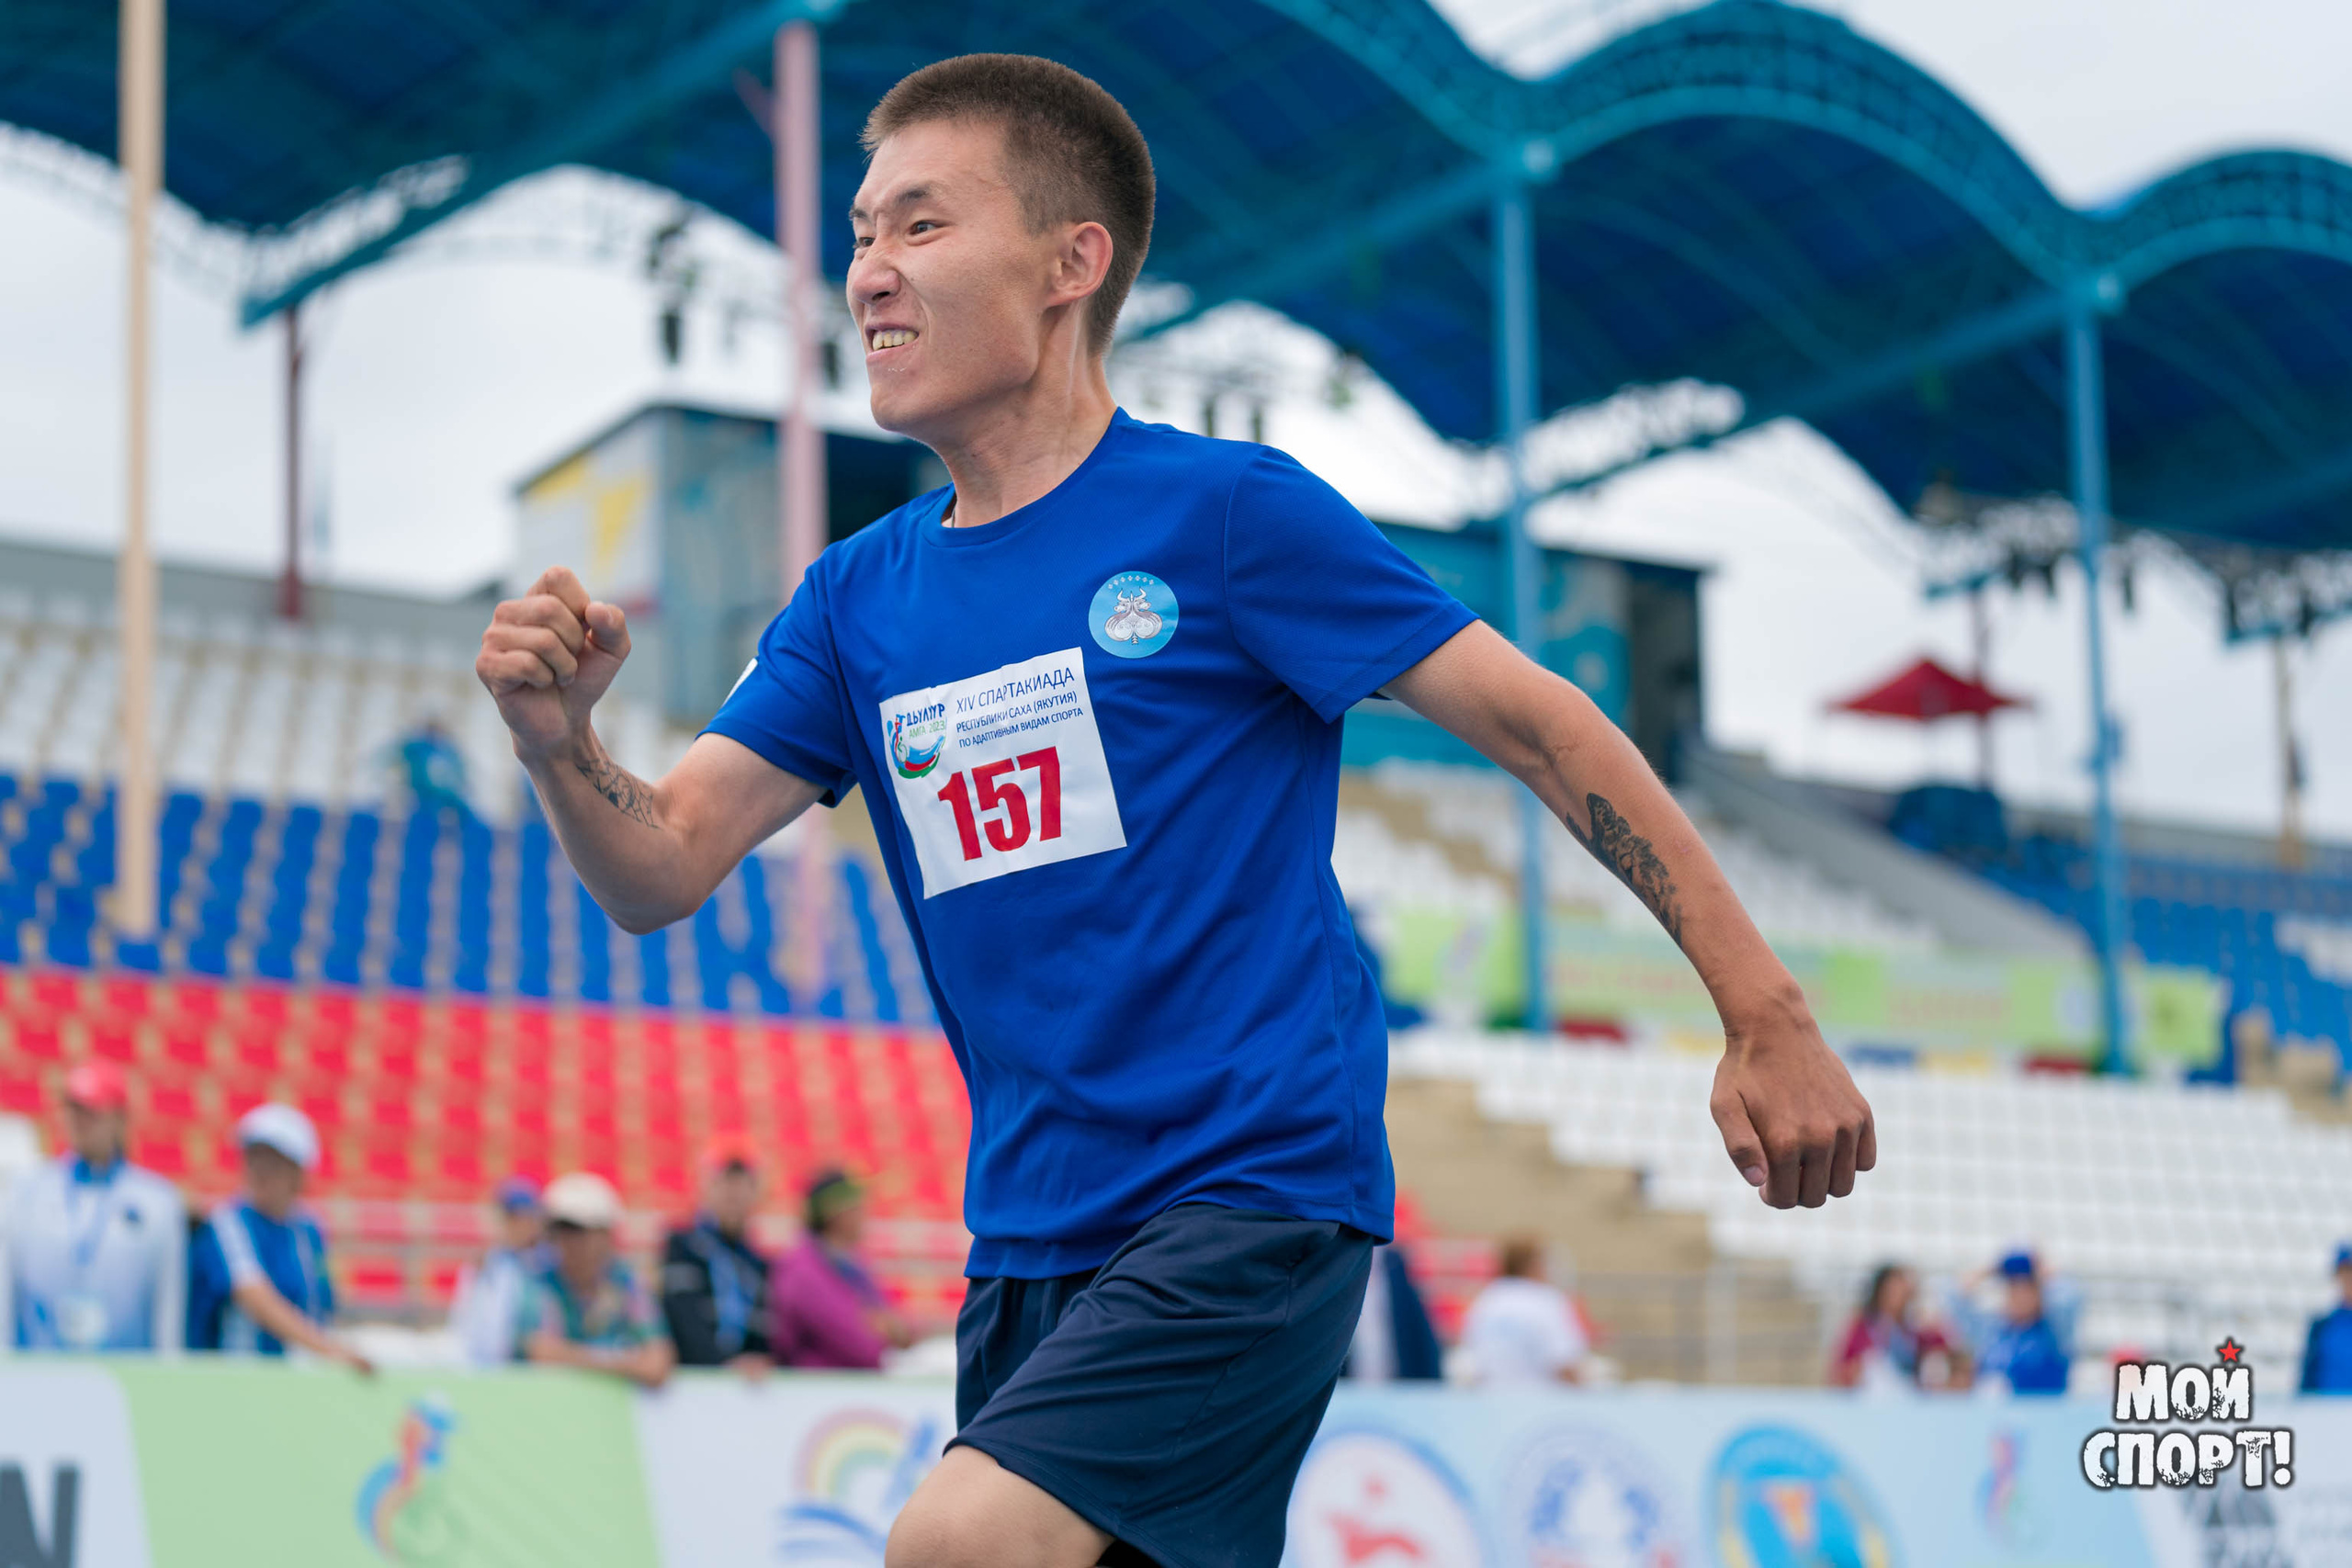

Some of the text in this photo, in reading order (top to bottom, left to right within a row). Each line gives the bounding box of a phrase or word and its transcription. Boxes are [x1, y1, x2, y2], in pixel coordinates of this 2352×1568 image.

[956, 695, 975, 714] XIV
[956, 691, 1078, 733] РЕСПУБЛИКИ САХА (ЯКУТИЯ)
[959, 708, 1084, 748] ПО АДАПТИВНЫМ ВИДАМ СПОРТА
[937, 746, 1062, 862] 157
